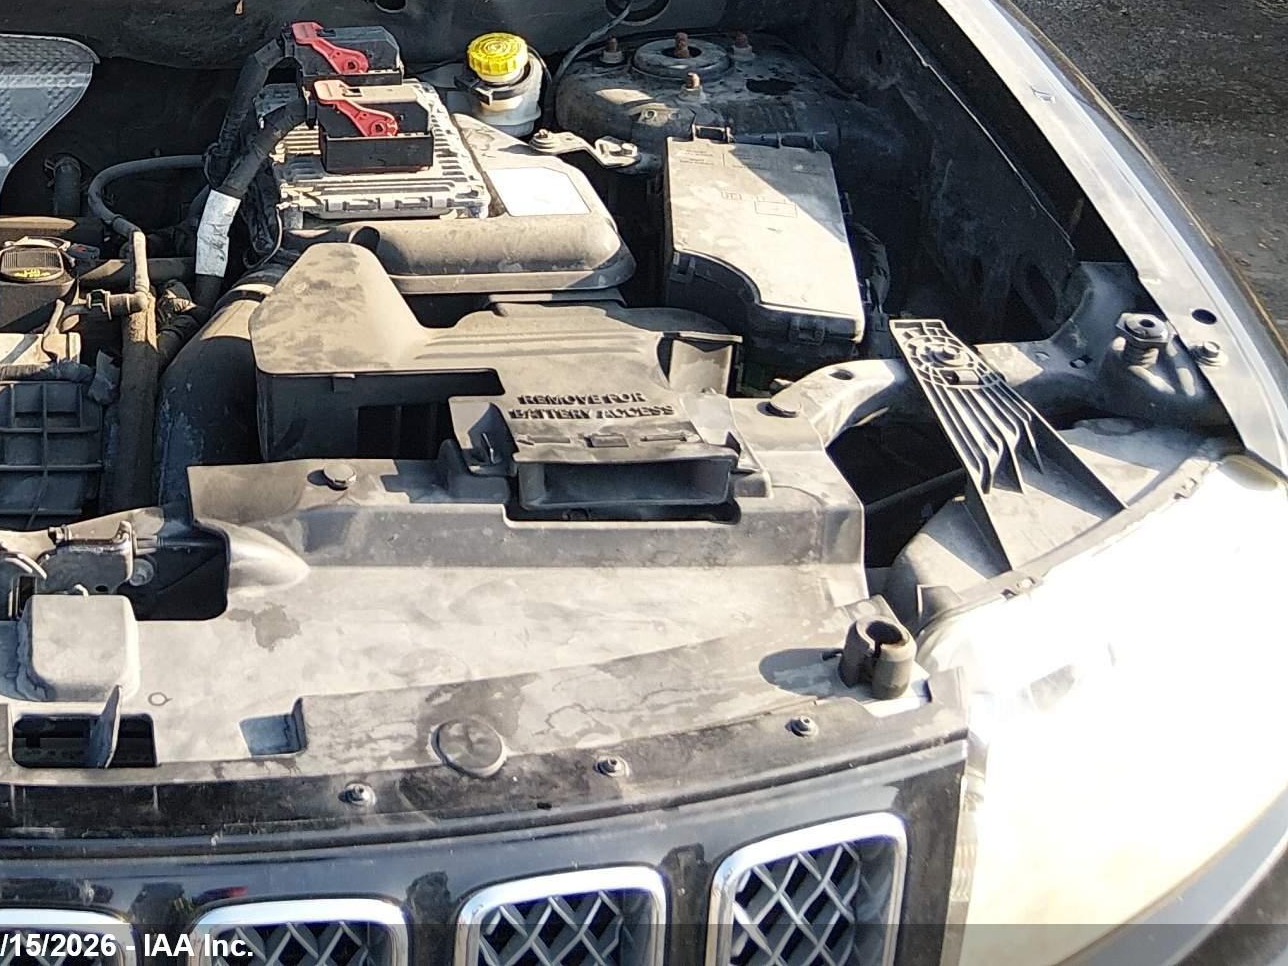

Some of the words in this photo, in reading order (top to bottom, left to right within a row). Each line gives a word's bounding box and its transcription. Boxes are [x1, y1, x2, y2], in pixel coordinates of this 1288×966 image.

[517, 394, 602, 405] REMOVE
[603, 392, 647, 404] FOR
[508, 408, 592, 420] BATTERY
[595, 405, 676, 419] ACCESS
